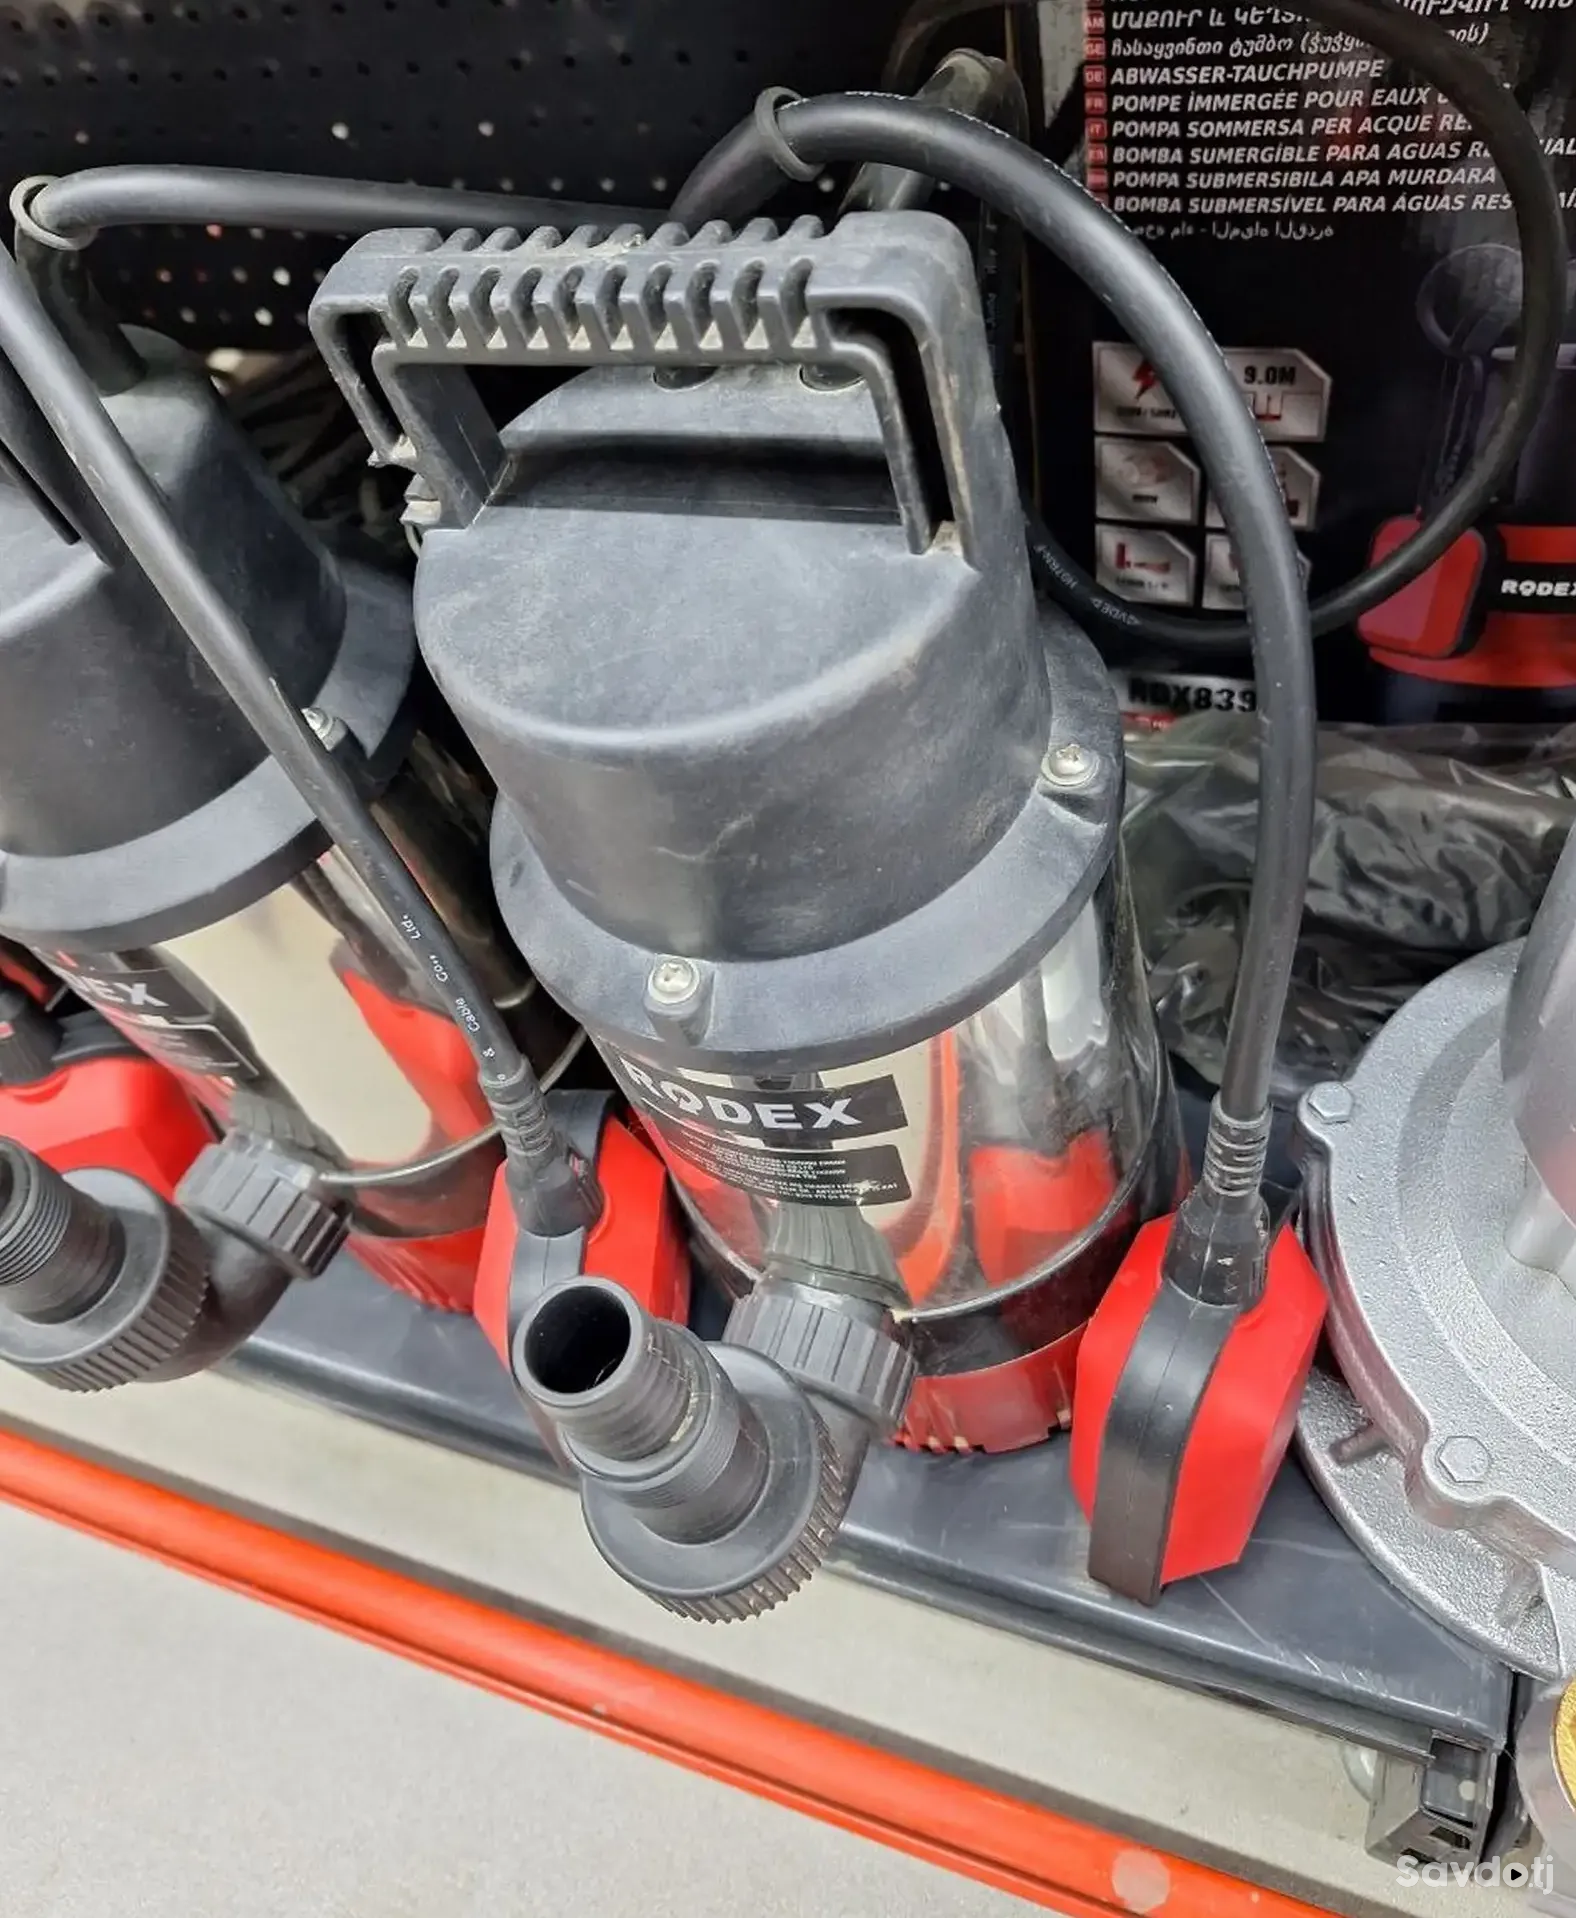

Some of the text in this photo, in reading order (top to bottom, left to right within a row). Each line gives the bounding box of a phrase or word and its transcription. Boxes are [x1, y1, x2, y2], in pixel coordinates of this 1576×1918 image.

[1110, 59, 1385, 85] ABWASSER-TAUCHPUMPE
[1111, 94, 1182, 112] POMPE
[1304, 89, 1364, 109] POUR
[1371, 86, 1431, 106] EAUX
[1111, 120, 1180, 138] POMPA
[1186, 118, 1304, 138] SOMMERSA
[1310, 116, 1351, 134] PER
[1357, 114, 1433, 136] ACQUE
[1112, 147, 1183, 164] BOMBA
[1325, 143, 1380, 162] PARA
[1386, 141, 1463, 160] AGUAS
[1113, 171, 1180, 188] POMPA
[1186, 169, 1334, 189] SUBMERSIBILA
[1339, 169, 1381, 187] APA
[1387, 167, 1496, 186] MURDARA
[1113, 196, 1183, 213] BOMBA
[1332, 195, 1386, 213] PARA
[1244, 365, 1297, 386] 9.0M
[455, 996, 481, 1033] Cable
[619, 1056, 863, 1130] RODEX
